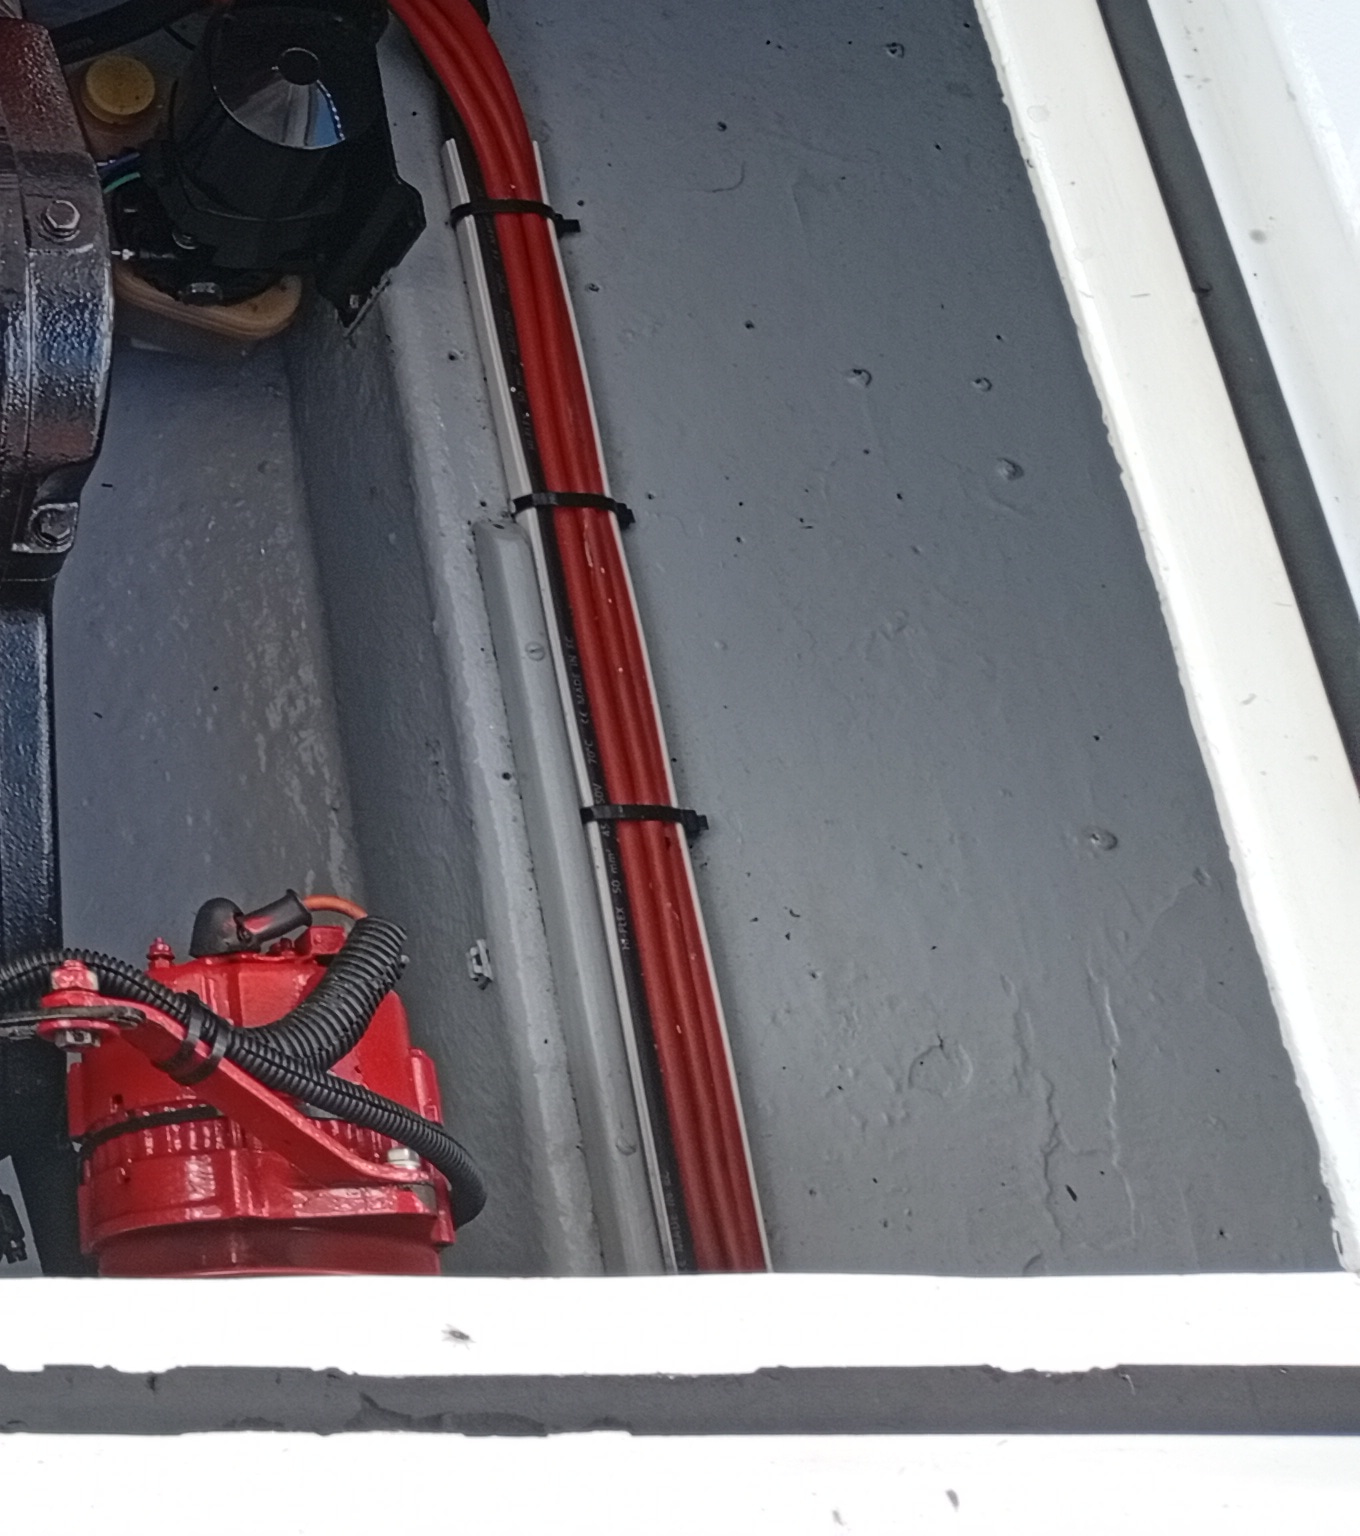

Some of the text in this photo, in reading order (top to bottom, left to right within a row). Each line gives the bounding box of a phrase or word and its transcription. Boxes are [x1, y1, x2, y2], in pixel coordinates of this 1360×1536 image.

[567, 654, 579, 667] IN
[570, 671, 586, 705] MADE
[583, 738, 598, 765] 70°C
[610, 877, 622, 894] 50
